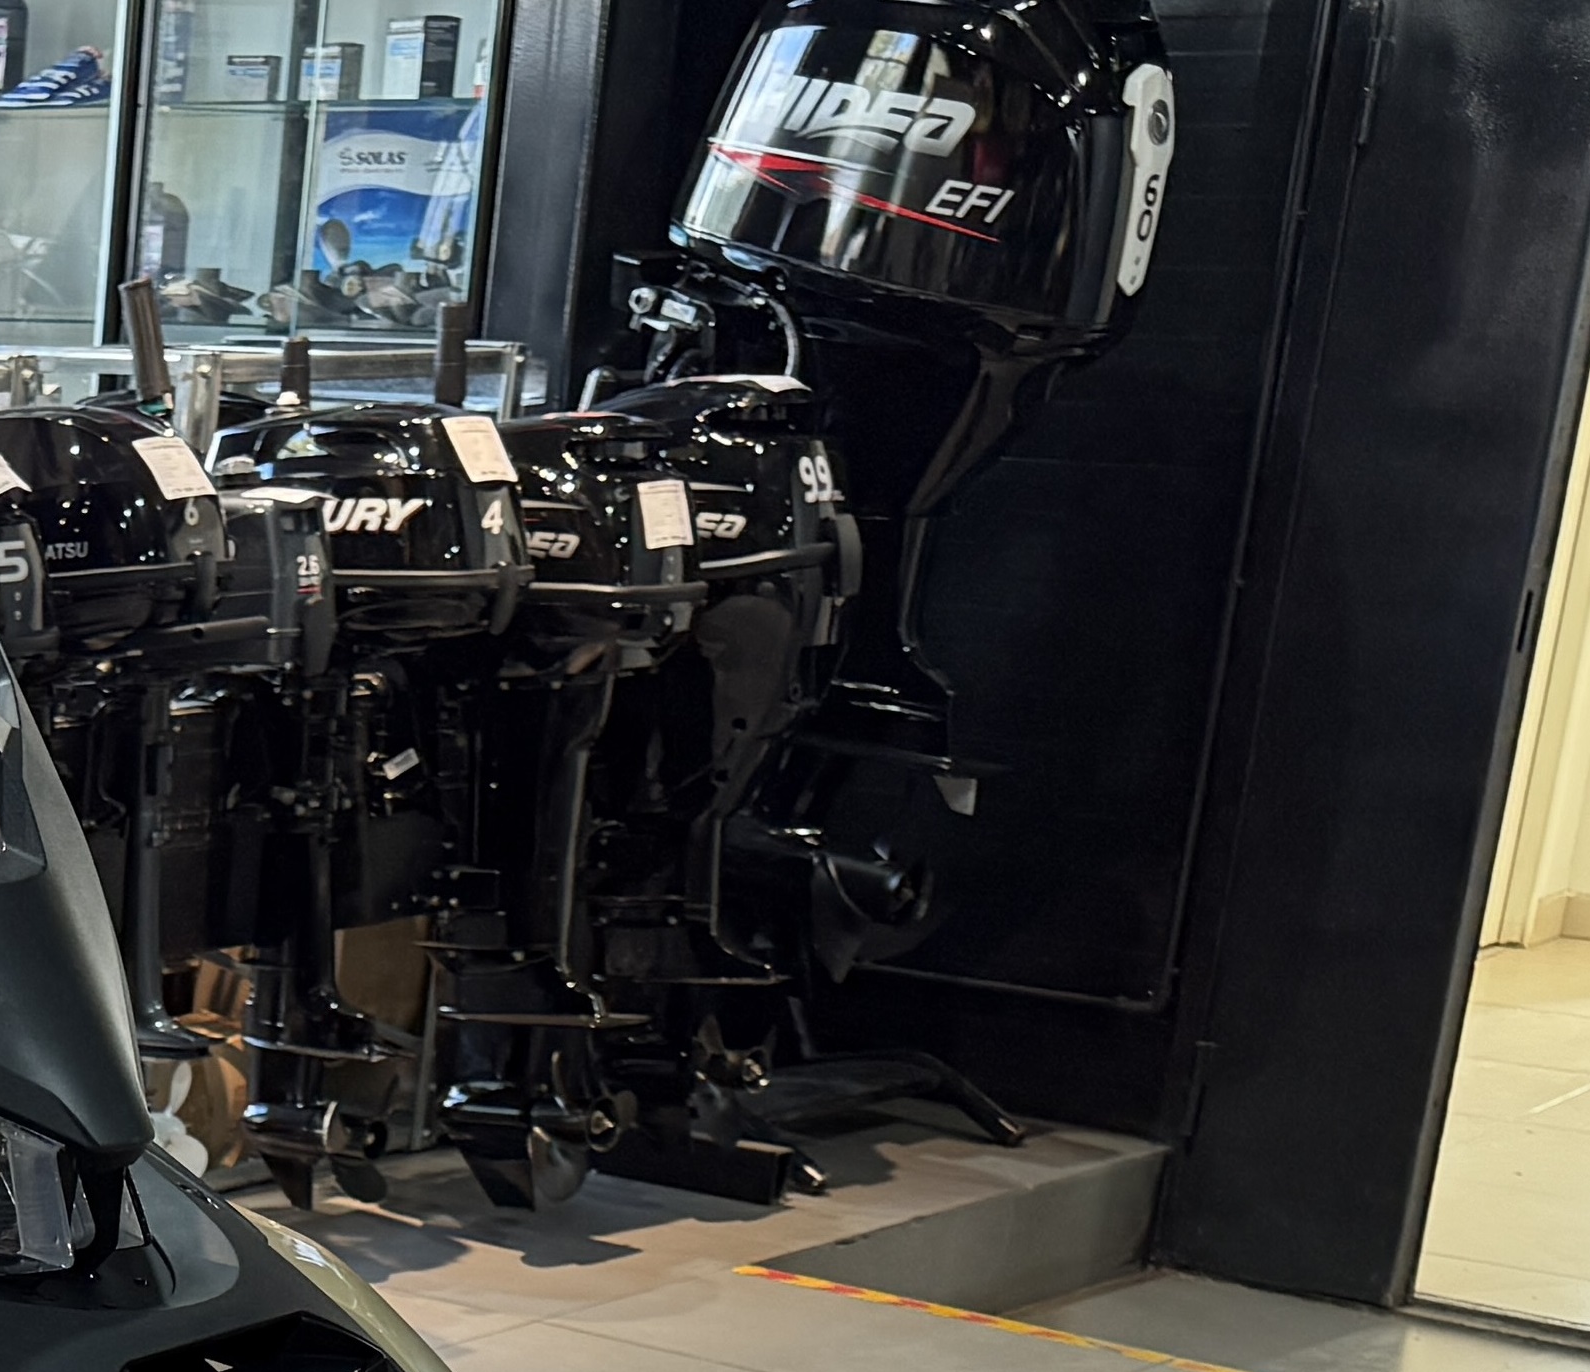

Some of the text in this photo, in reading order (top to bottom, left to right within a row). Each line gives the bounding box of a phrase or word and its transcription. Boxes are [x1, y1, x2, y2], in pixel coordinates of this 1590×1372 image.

[925, 179, 1015, 223] EFI
[481, 500, 503, 534] 4
[44, 542, 88, 560] ATSU
